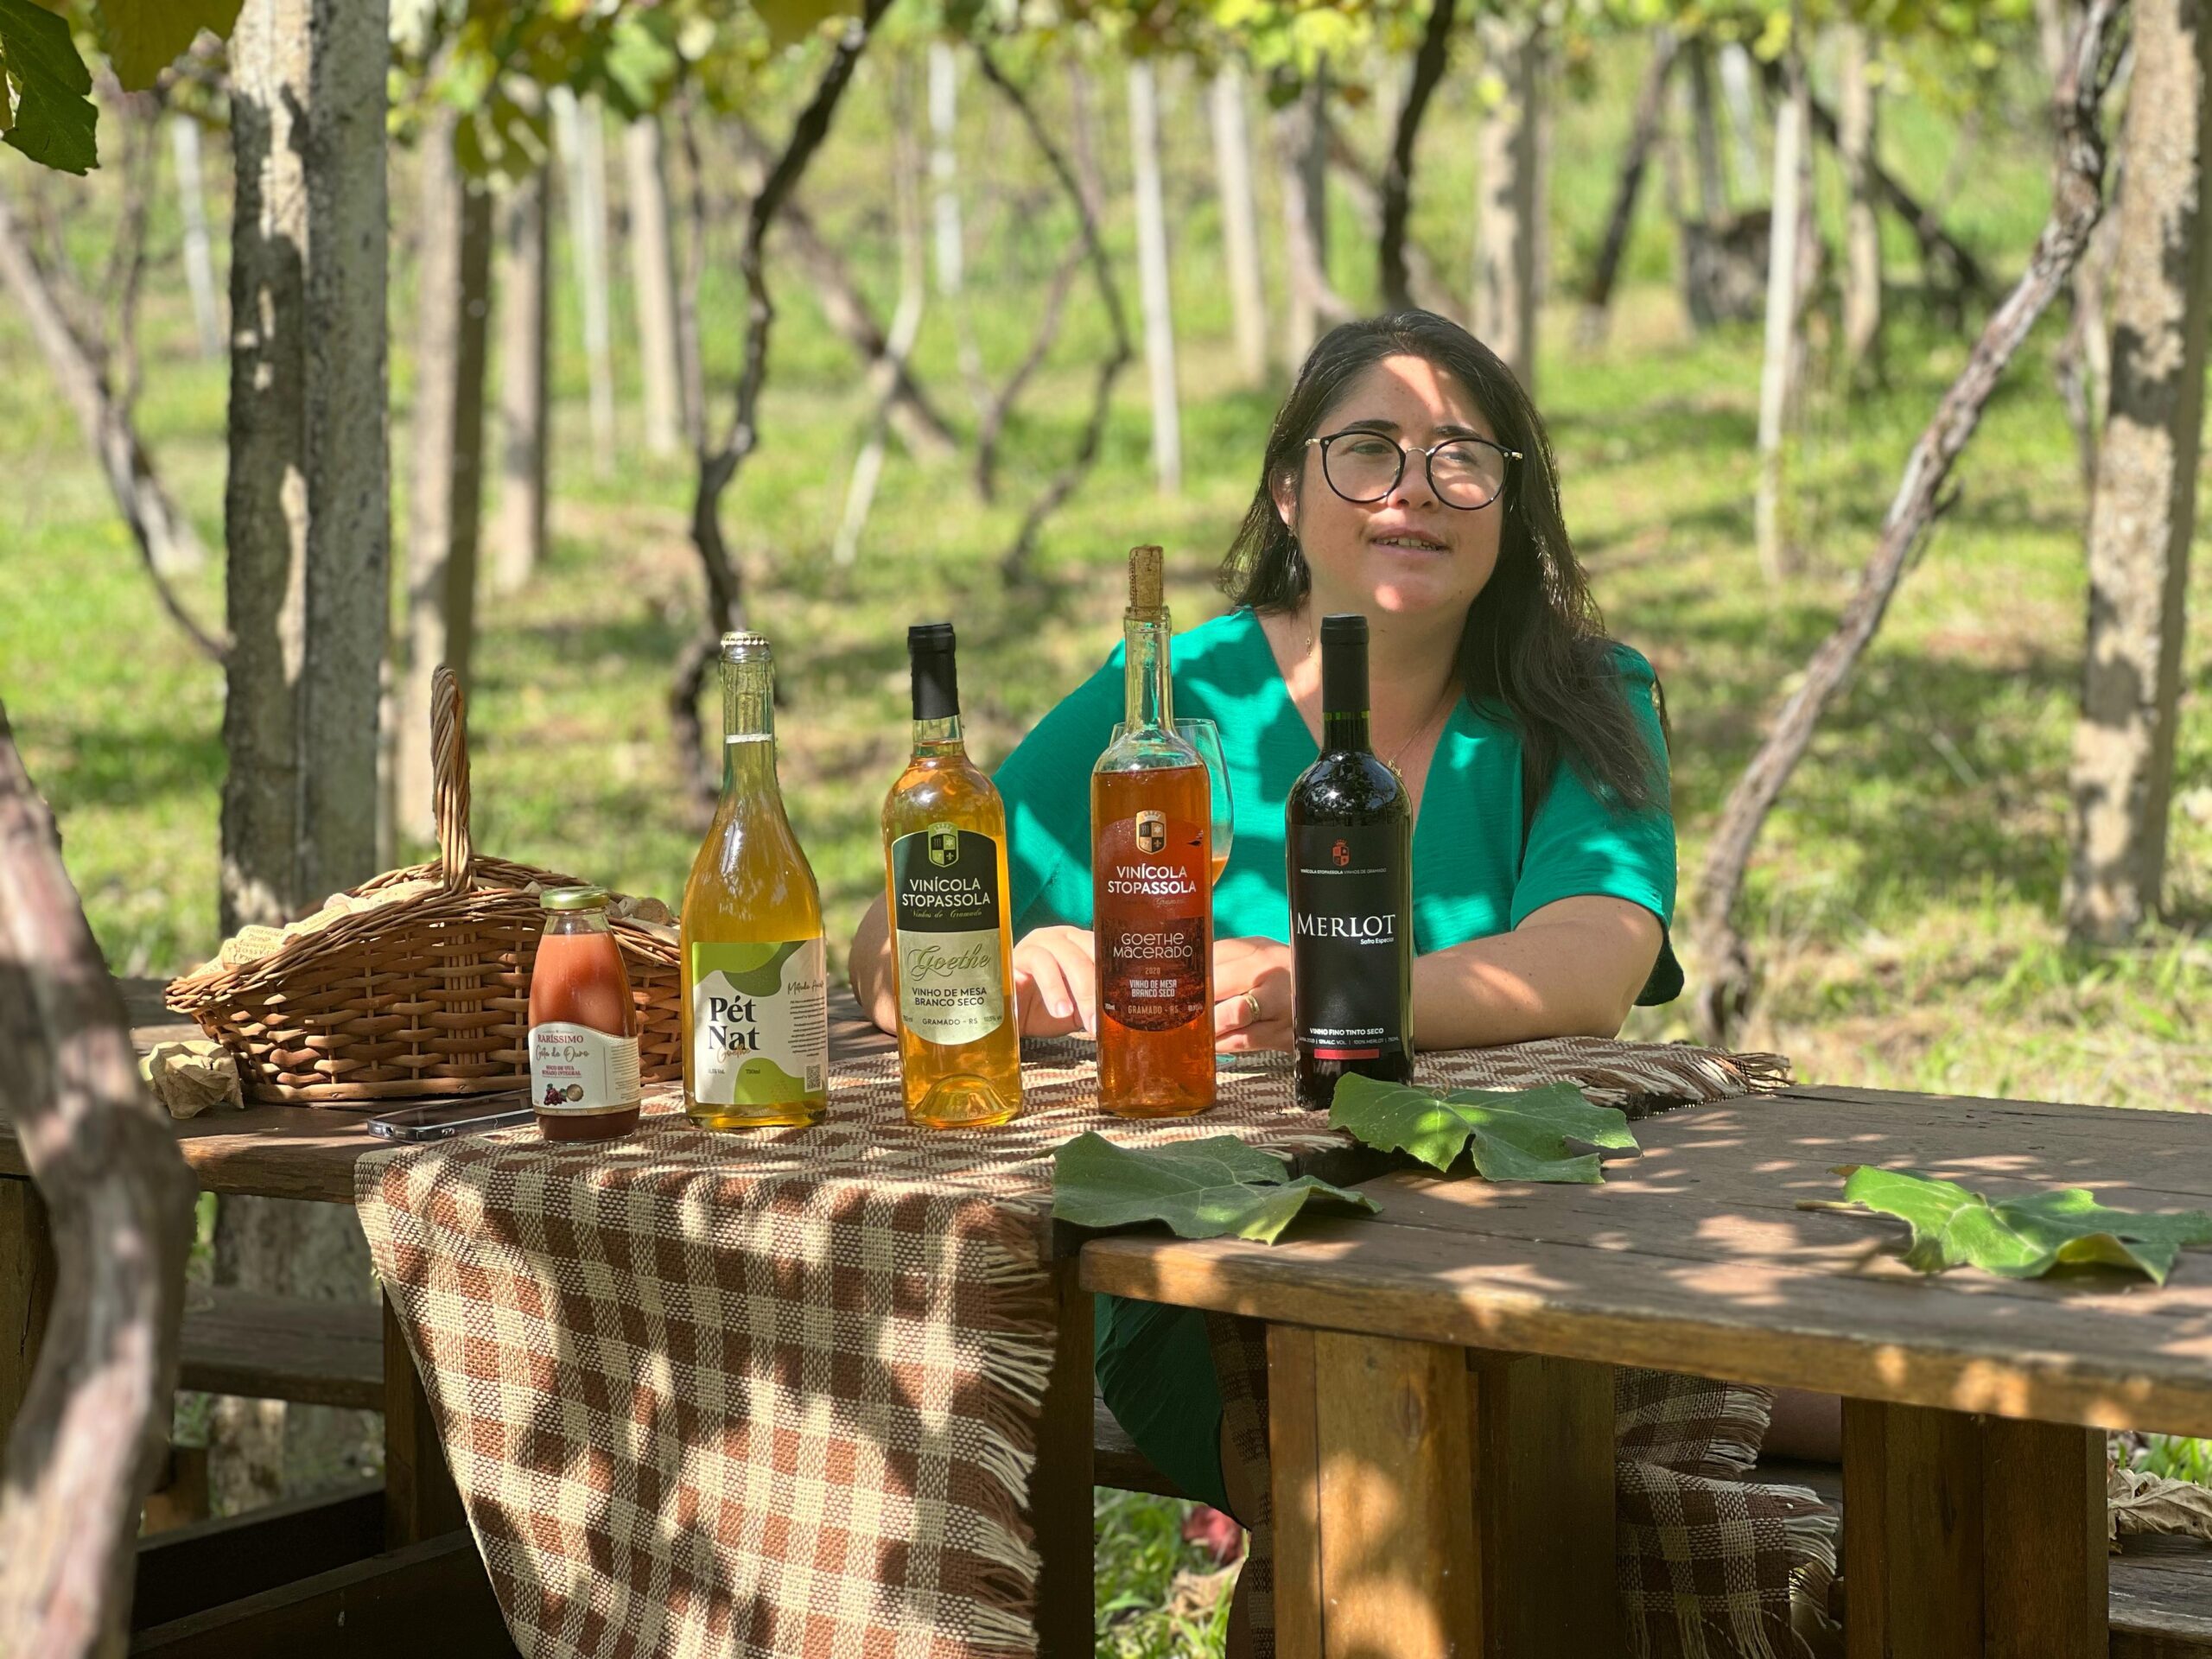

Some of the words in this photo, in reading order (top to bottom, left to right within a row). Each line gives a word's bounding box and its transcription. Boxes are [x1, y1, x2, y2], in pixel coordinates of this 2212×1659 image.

[1116, 863, 1187, 880] VINÍCOLA
[910, 876, 981, 892] VINÍCOLA
[1108, 880, 1197, 894] STOPASSOLA
[902, 893, 991, 907] STOPASSOLA
[912, 909, 931, 918] Vinhos
[950, 908, 982, 918] Gramado
[907, 943, 991, 982] Goethe
[1129, 979, 1149, 988] VINHO
[1150, 980, 1159, 988] DE
[1160, 979, 1177, 988] MESA
[912, 987, 941, 997] VINHO
[944, 988, 957, 997] DE
[961, 987, 987, 997] MESA
[1131, 988, 1157, 997] BRANCO
[1159, 988, 1175, 997] SECO
[915, 998, 955, 1007] BRANCO
[957, 997, 984, 1006] SECO
[709, 995, 757, 1023] Pét
[1128, 1005, 1162, 1014] GRAMADO
[1170, 1005, 1179, 1014] RS
[537, 1033, 584, 1043] RARÍSSIMO
[708, 1026, 760, 1051] Nat
